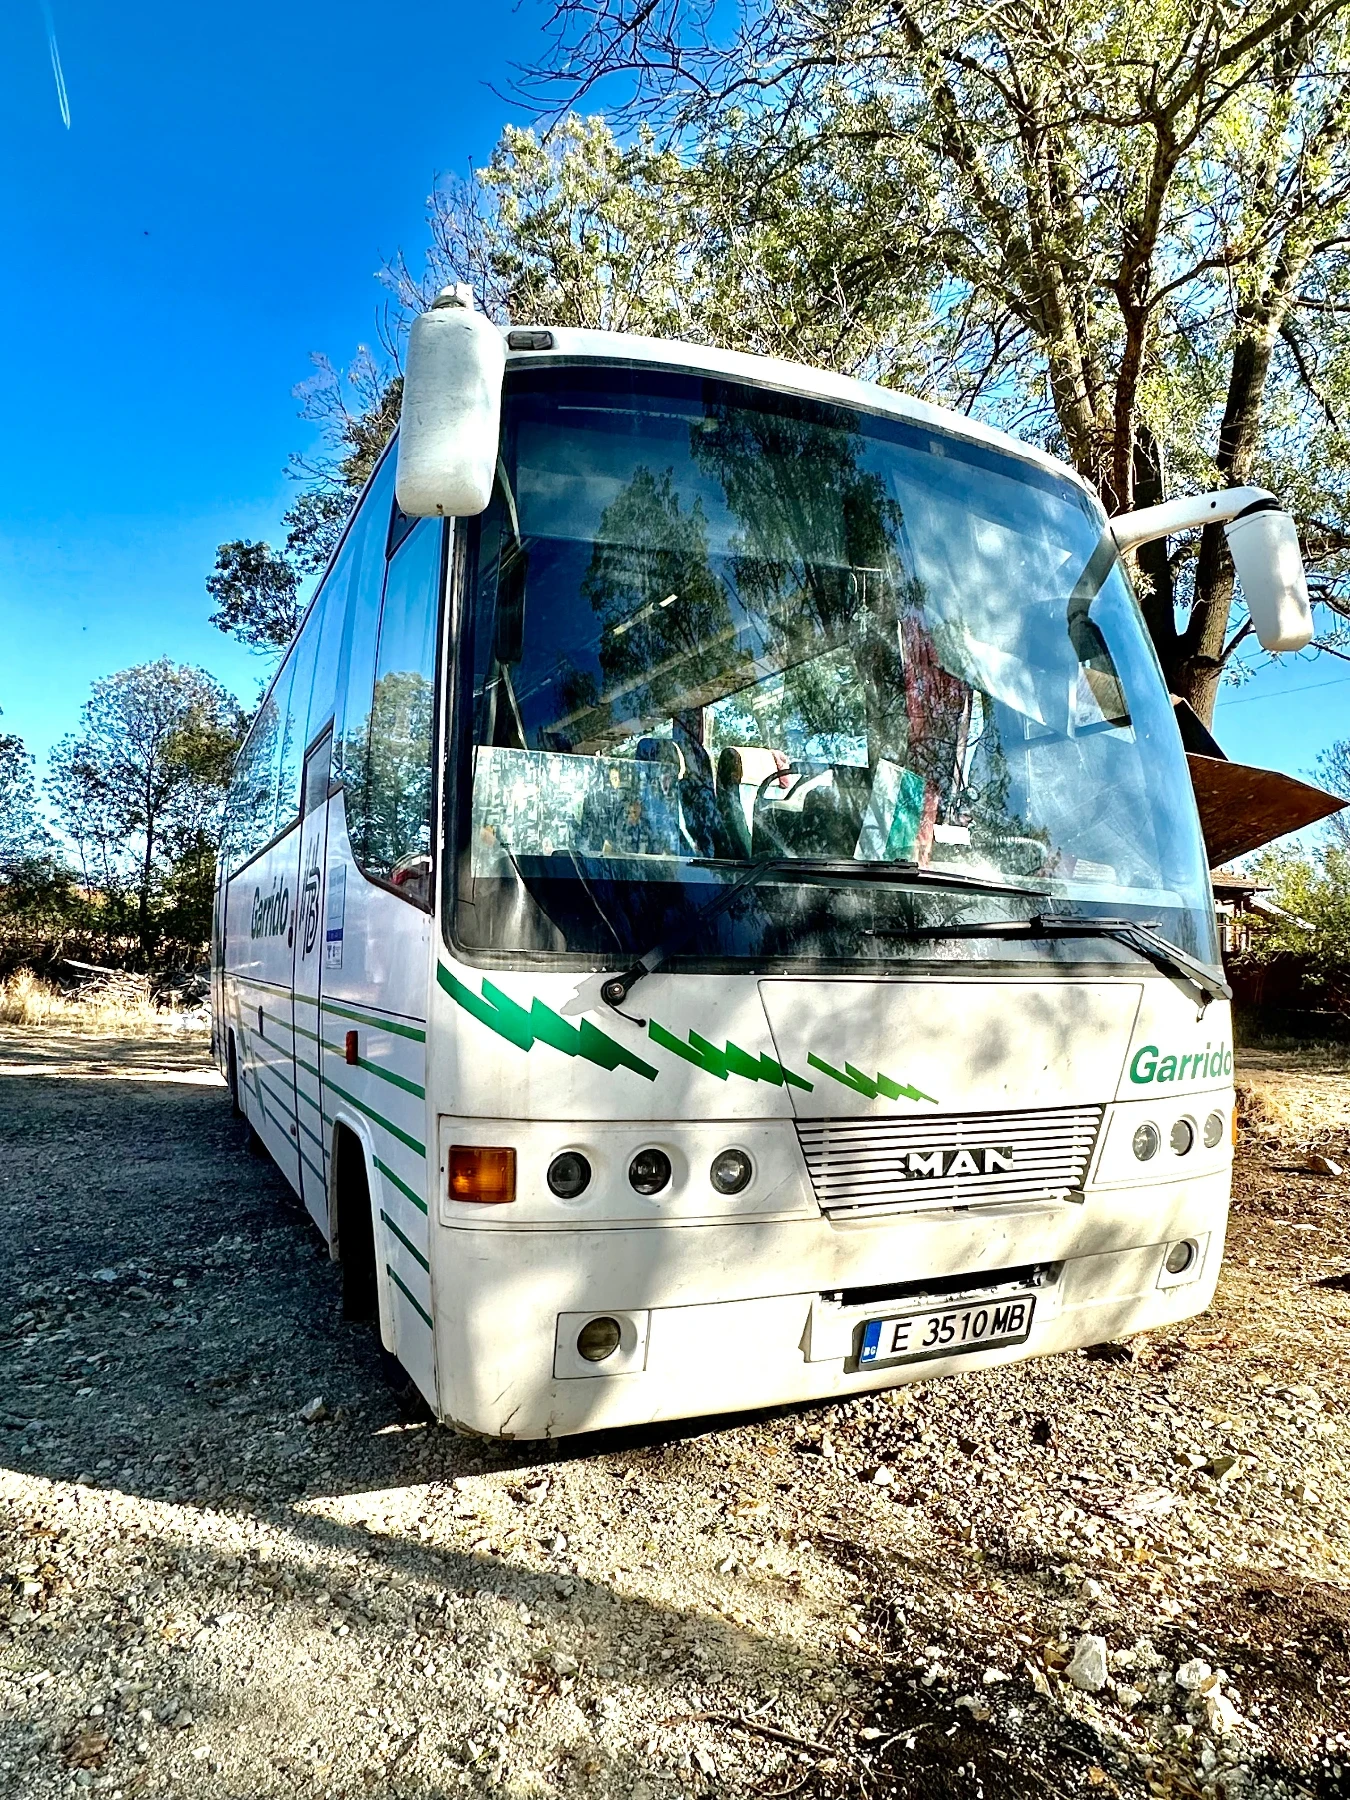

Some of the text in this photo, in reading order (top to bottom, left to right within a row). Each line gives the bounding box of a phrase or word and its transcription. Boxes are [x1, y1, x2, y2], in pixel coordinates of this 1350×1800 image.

[251, 873, 289, 940] Garrido
[1129, 1041, 1232, 1084] Garrido
[907, 1147, 1014, 1178] MAN
[890, 1322, 912, 1353] E
